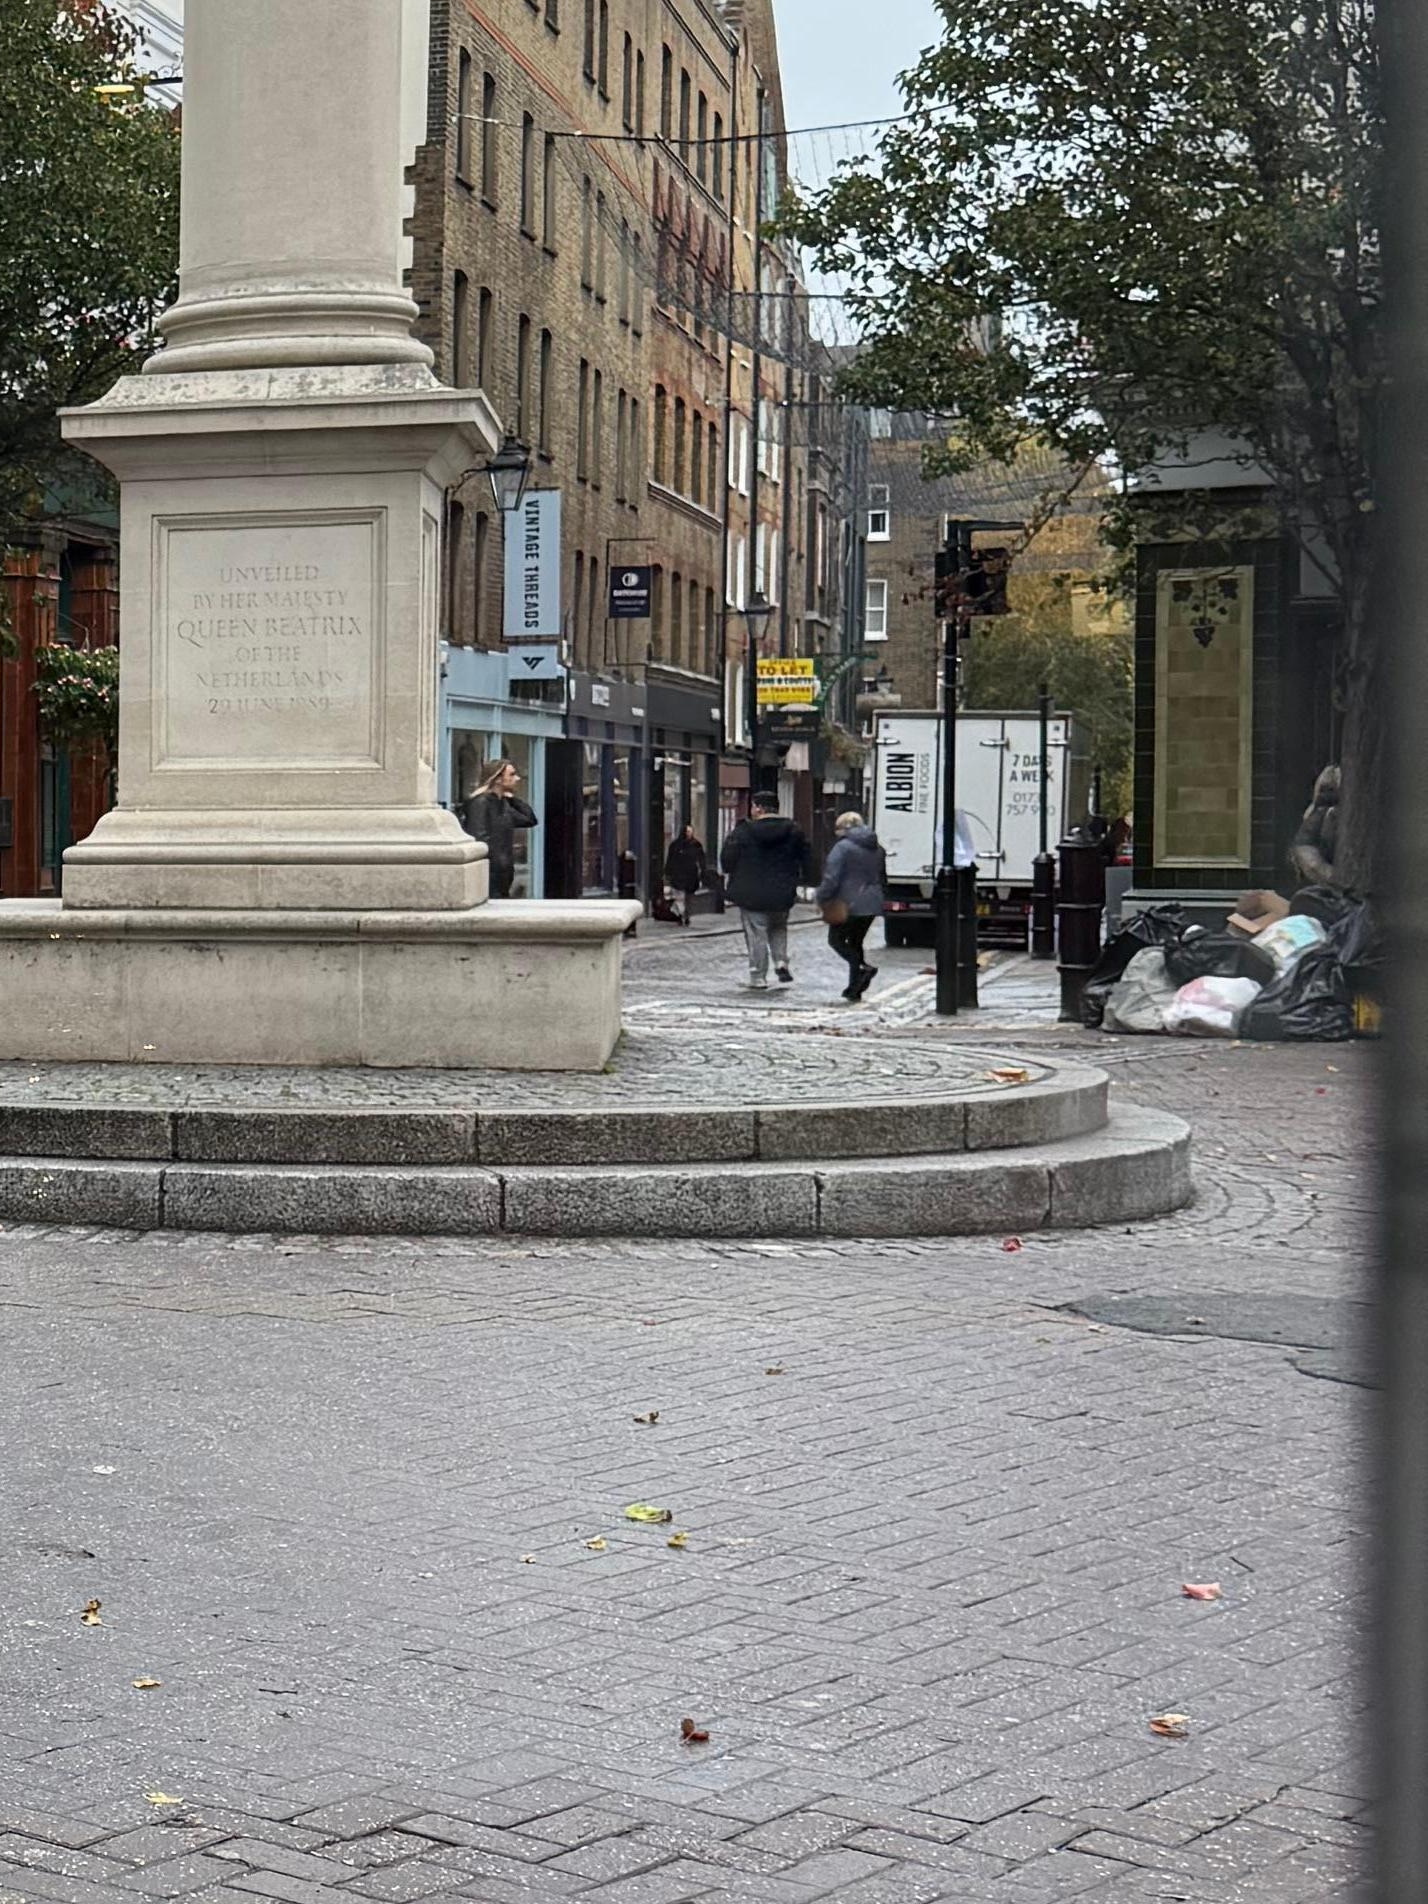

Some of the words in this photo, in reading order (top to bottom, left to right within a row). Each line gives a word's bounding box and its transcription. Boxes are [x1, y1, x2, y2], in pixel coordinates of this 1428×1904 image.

[525, 499, 540, 560] VINTAGE
[219, 565, 320, 583] UNVEILED
[194, 594, 215, 609] BY
[220, 592, 259, 609] HER
[524, 565, 540, 629] THREADS
[177, 618, 257, 648] QUEEN
[265, 615, 363, 637] BEATRIX
[235, 647, 261, 663] OF
[263, 646, 302, 663] THE
[195, 670, 345, 688] NETHERLANDS
[759, 665, 777, 676] TO
[780, 665, 808, 676] LET
[1012, 754, 1020, 767] 7
[1023, 754, 1053, 768] DAS
[919, 752, 931, 789] FOODS
[1009, 770, 1018, 783] A
[1021, 770, 1054, 783] WEK
[884, 752, 915, 813] ALBION
